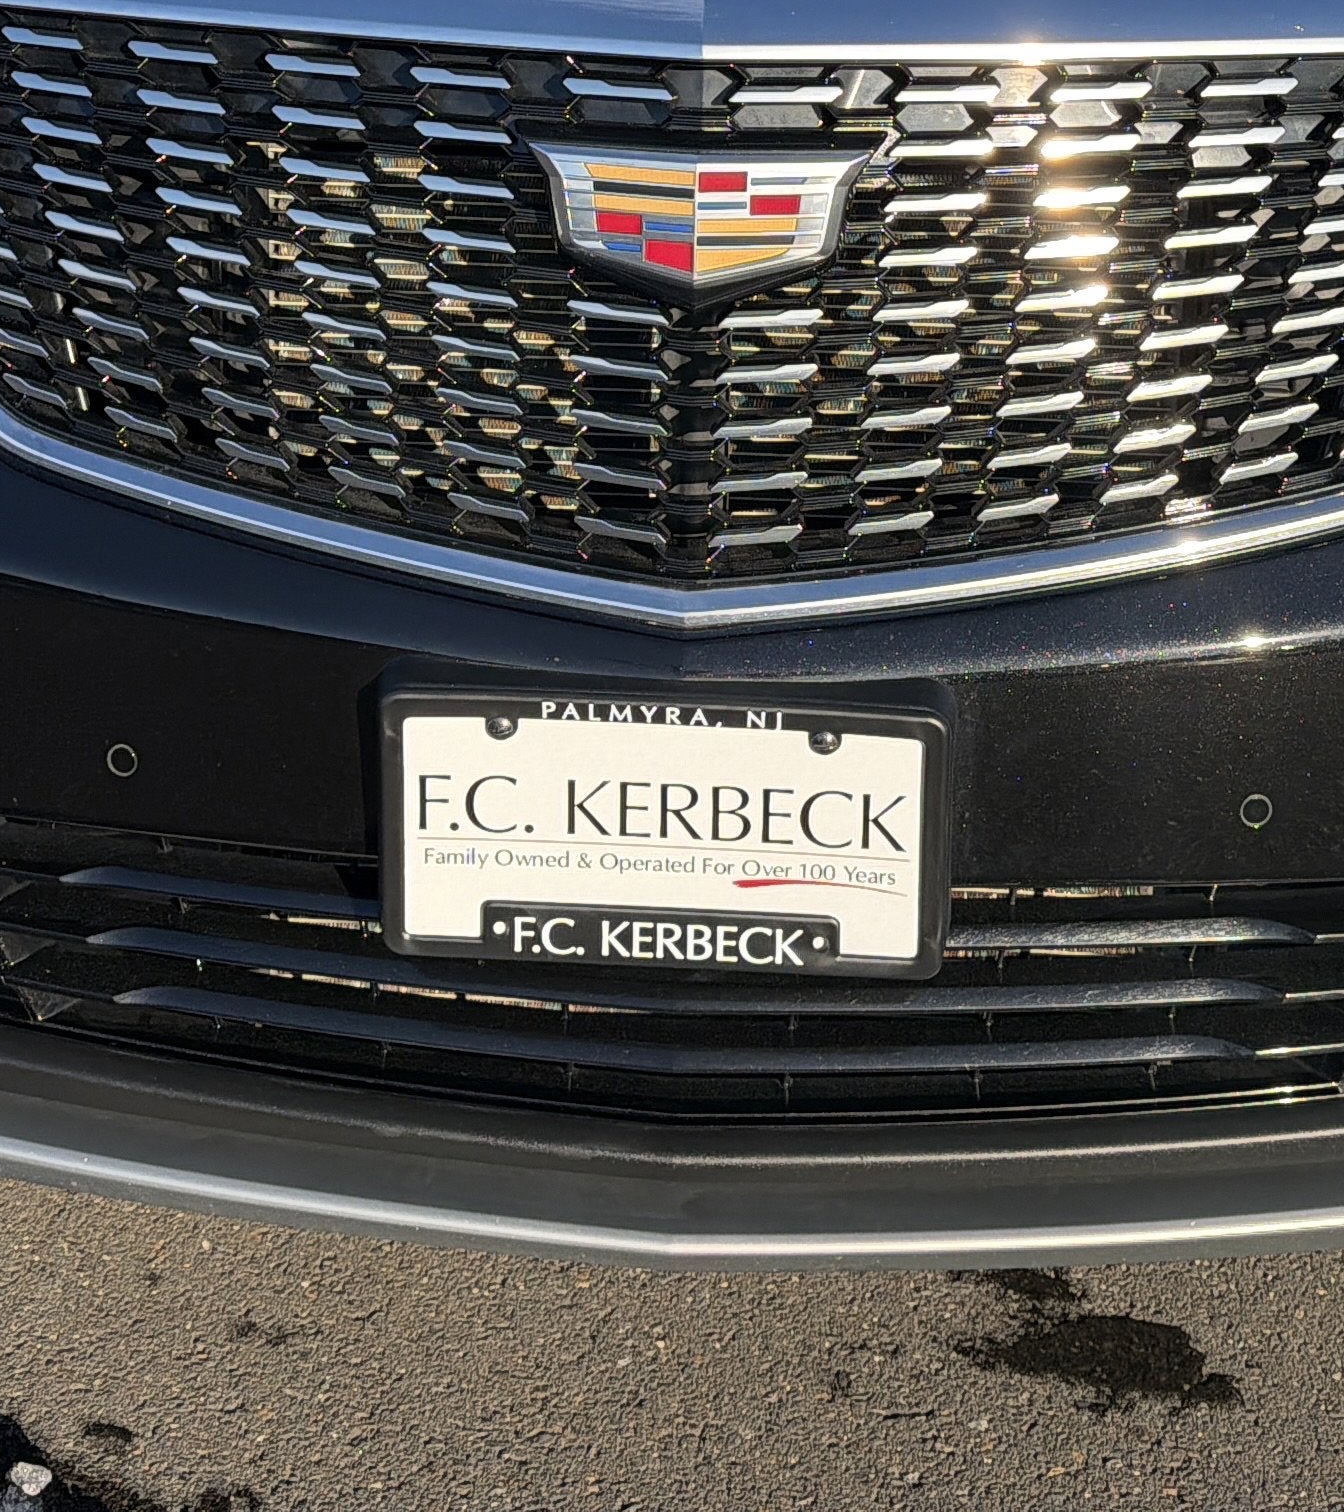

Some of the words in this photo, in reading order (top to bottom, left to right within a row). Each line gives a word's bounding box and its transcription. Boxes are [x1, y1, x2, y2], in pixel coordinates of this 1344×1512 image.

[541, 701, 723, 728] PALMYRA,
[746, 709, 783, 731] NJ
[418, 774, 535, 834] F.C.
[566, 778, 908, 854] KERBECK
[424, 848, 489, 868] Family
[495, 849, 570, 868] Owned
[577, 851, 593, 869] &
[599, 852, 696, 876] Operated
[702, 858, 735, 876] For
[742, 859, 793, 878] Over
[800, 862, 836, 881] 100
[843, 865, 896, 886] Years
[513, 916, 585, 957] F.C.
[601, 920, 805, 966] KERBECK
